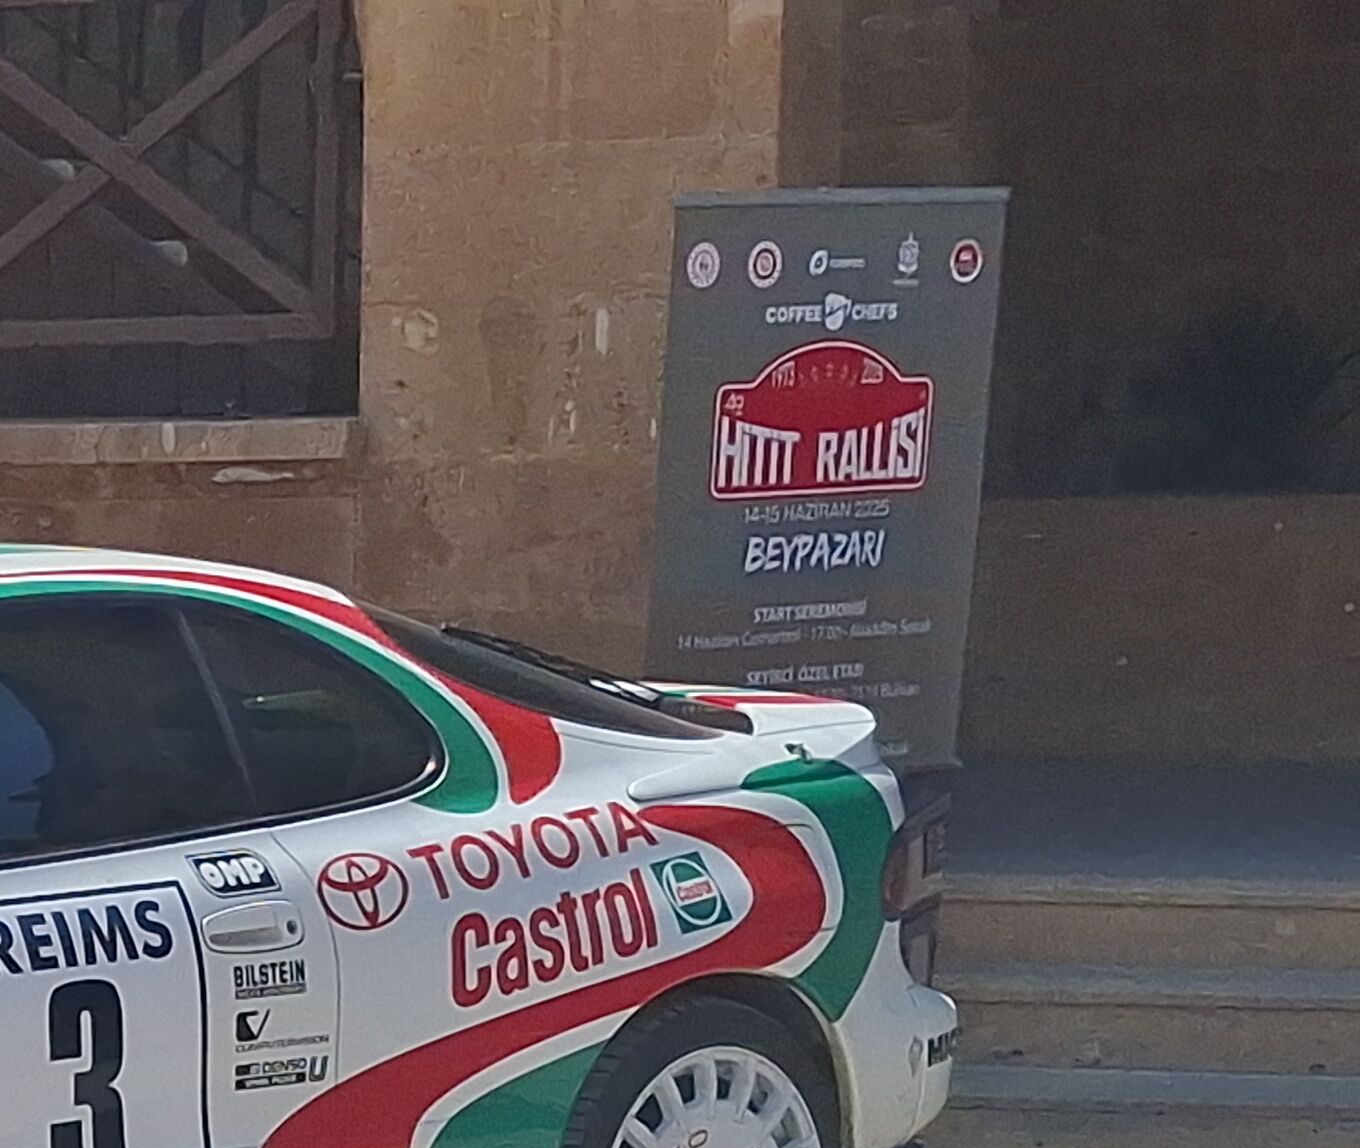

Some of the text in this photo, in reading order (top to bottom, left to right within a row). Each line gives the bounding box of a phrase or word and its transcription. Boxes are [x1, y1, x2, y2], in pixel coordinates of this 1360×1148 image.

[765, 304, 822, 324] COFFEE
[743, 529, 886, 574] BEYPAZARI
[406, 801, 660, 901] TOYOTA
[198, 856, 265, 890] OMP
[450, 866, 659, 1009] Castrol
[232, 958, 306, 988] BILSTEIN
